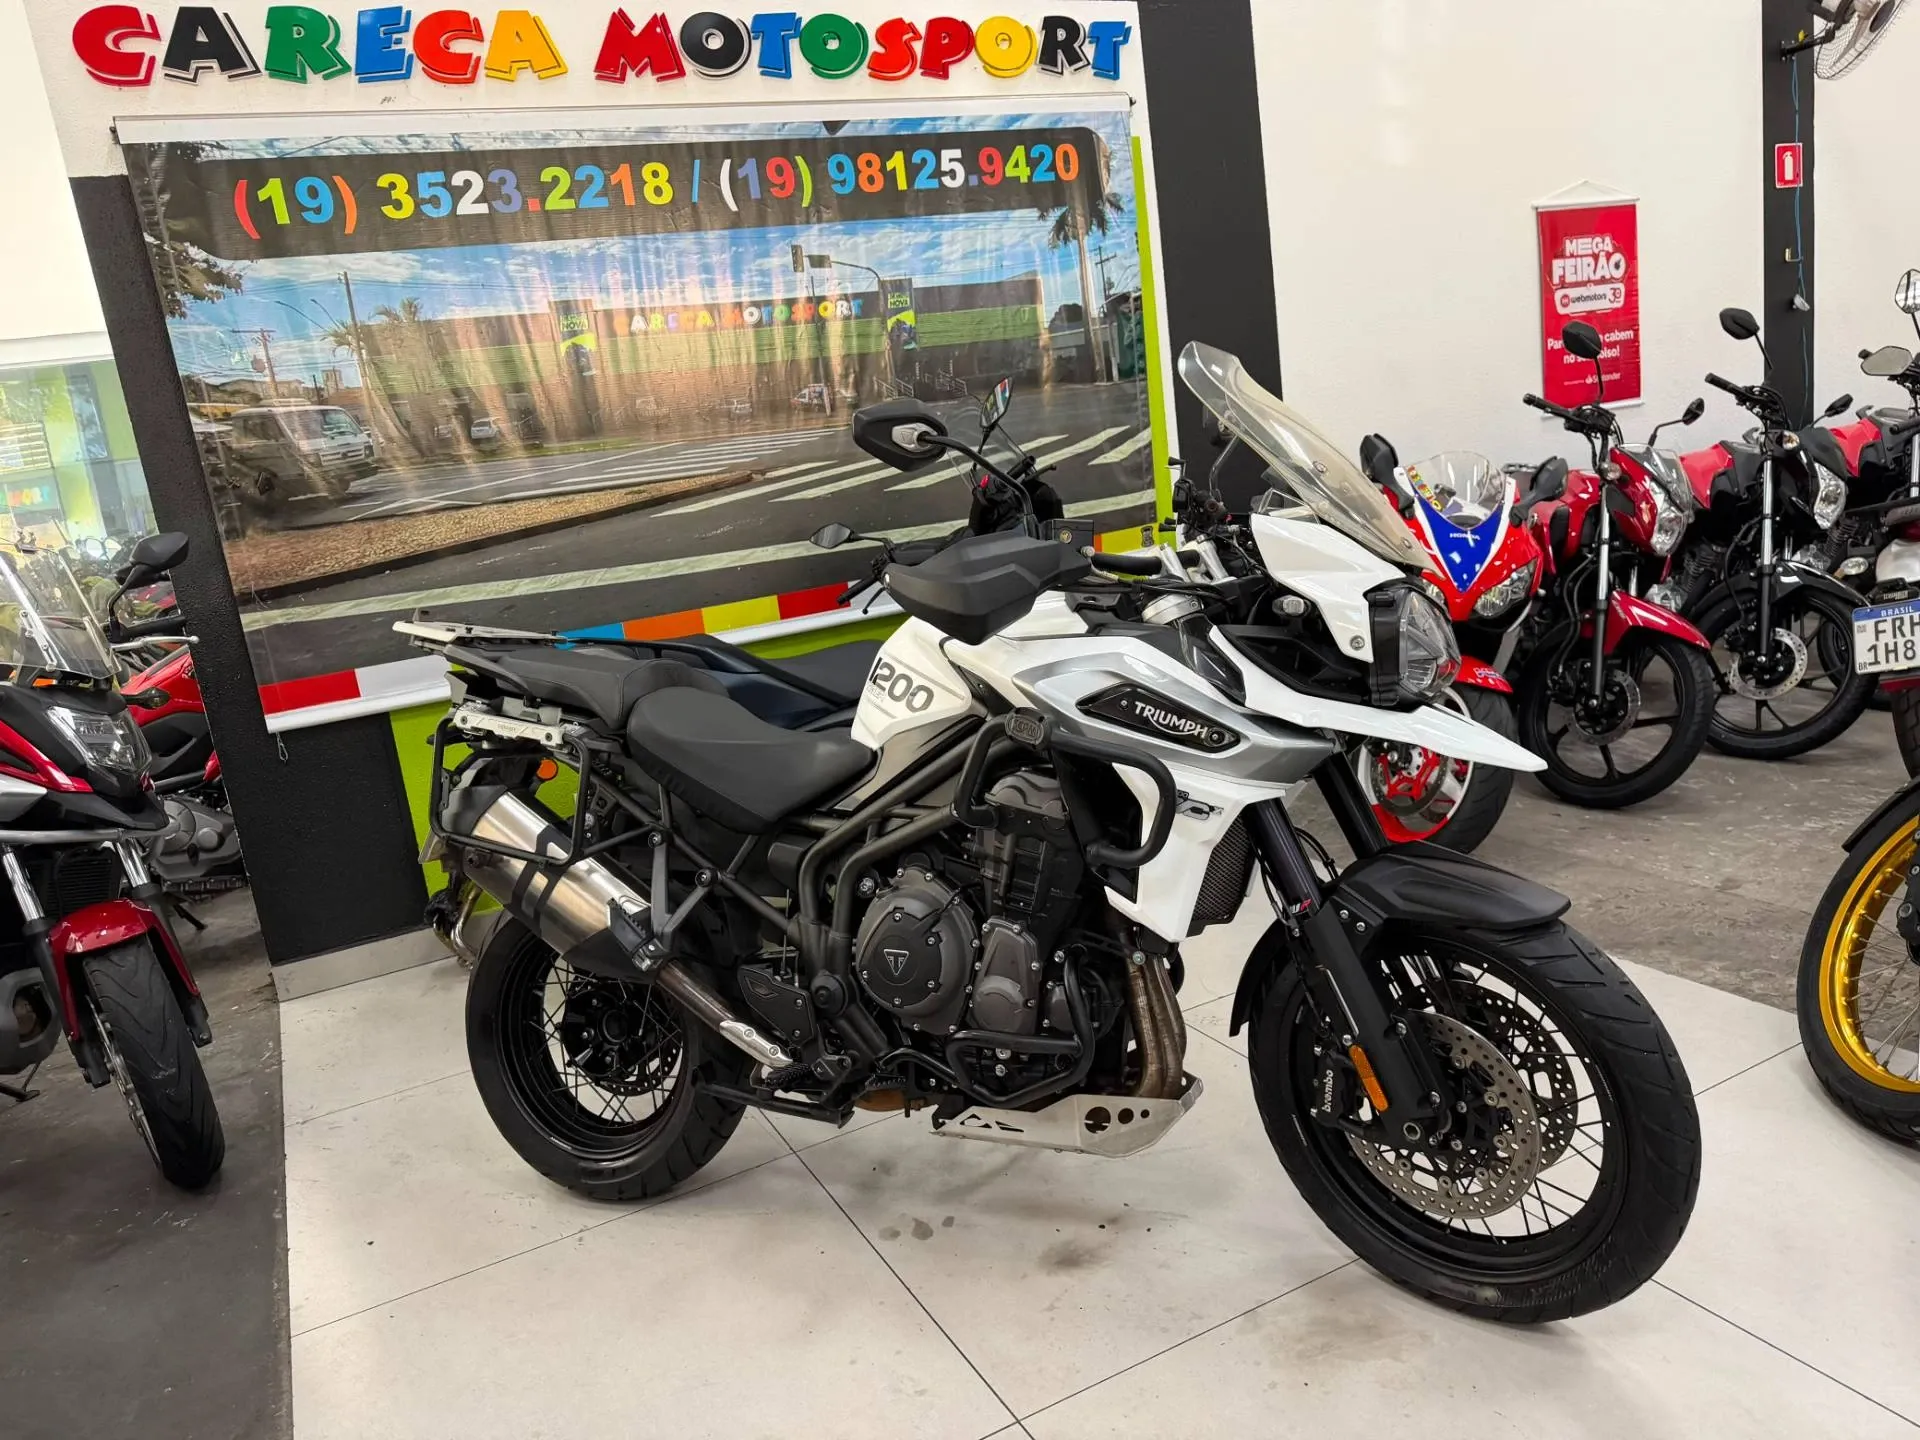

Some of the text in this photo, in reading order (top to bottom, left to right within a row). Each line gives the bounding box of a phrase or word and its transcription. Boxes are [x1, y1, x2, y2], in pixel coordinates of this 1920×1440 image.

[72, 4, 1131, 86] CARECA MOTOSPORT
[233, 143, 1080, 239] (19) 3523.2218 / (19) 98125.9420
[1565, 236, 1613, 256] MEGA
[1552, 251, 1626, 285] FEIRÃO
[1571, 293, 1607, 304] webmotors
[722, 299, 864, 331] MOTOSPORT
[1604, 328, 1634, 342] cabem
[1563, 354, 1575, 364] no
[1597, 345, 1620, 359] olso!
[1449, 532, 1481, 541] HONDA
[1881, 605, 1914, 617] BRASIL
[1858, 661, 1868, 671] BR
[1867, 639, 1916, 666] 1H8
[869, 656, 934, 713] 1200
[1135, 701, 1208, 739] TRIUMPH
[1321, 1069, 1334, 1113] brembo
